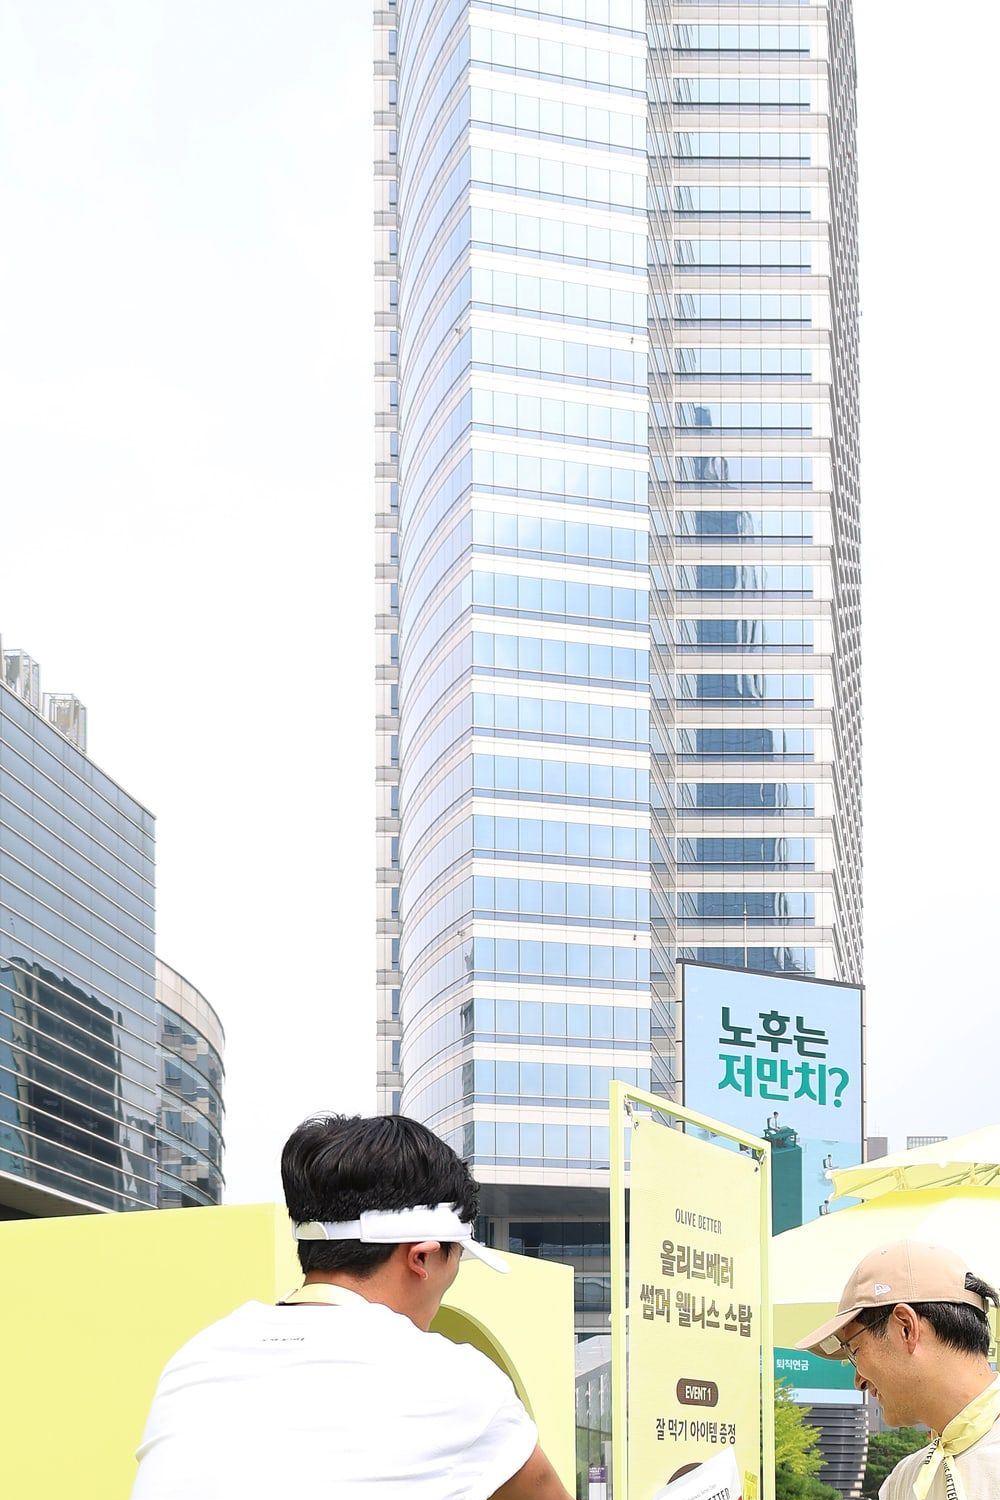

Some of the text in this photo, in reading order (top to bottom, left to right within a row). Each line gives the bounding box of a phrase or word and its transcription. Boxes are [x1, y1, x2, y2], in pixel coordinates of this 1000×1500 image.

[719, 1006, 829, 1059] 노후는
[718, 1053, 849, 1108] 저만치?
[675, 1208, 722, 1235] OLIVE BETTER
[660, 1240, 733, 1289] 올리브베러
[640, 1283, 752, 1338] 썸머 웰니스 스탑
[776, 1358, 810, 1371] 퇴직연금
[685, 1385, 707, 1400] EVENT
[656, 1418, 736, 1445] 잘 먹기 아이템 증정
